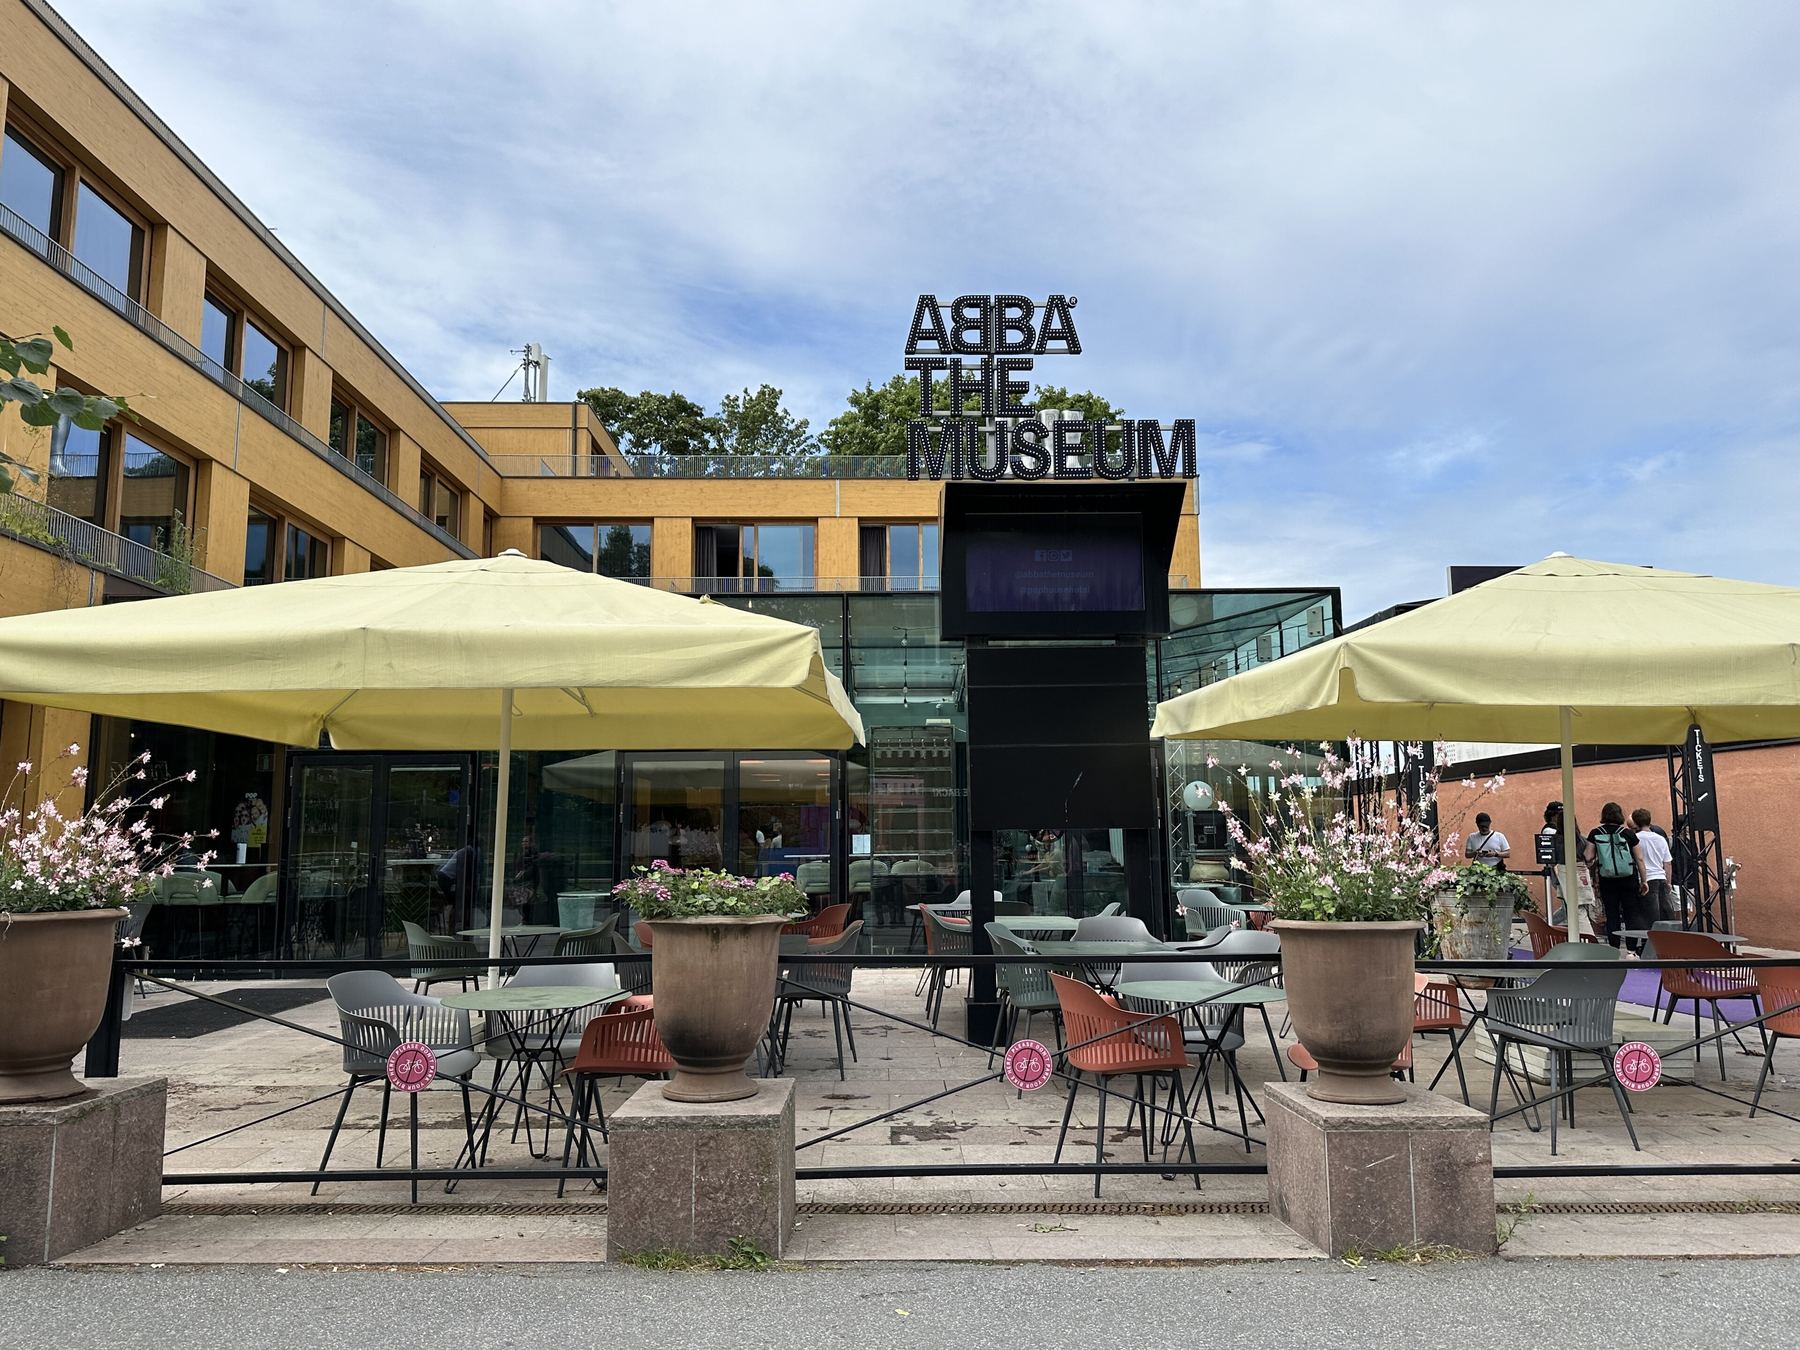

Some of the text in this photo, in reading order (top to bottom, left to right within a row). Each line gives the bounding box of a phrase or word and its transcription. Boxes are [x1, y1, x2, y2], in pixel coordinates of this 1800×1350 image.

[905, 358, 1035, 417] THE
[906, 419, 1197, 481] MUSEUM
[1693, 729, 1704, 782] TICKETS
[1419, 766, 1427, 819] TICKES
[396, 1044, 418, 1055] PLEASE
[1011, 1042, 1033, 1053] PLEASE
[1620, 1044, 1641, 1056] PLEASE
